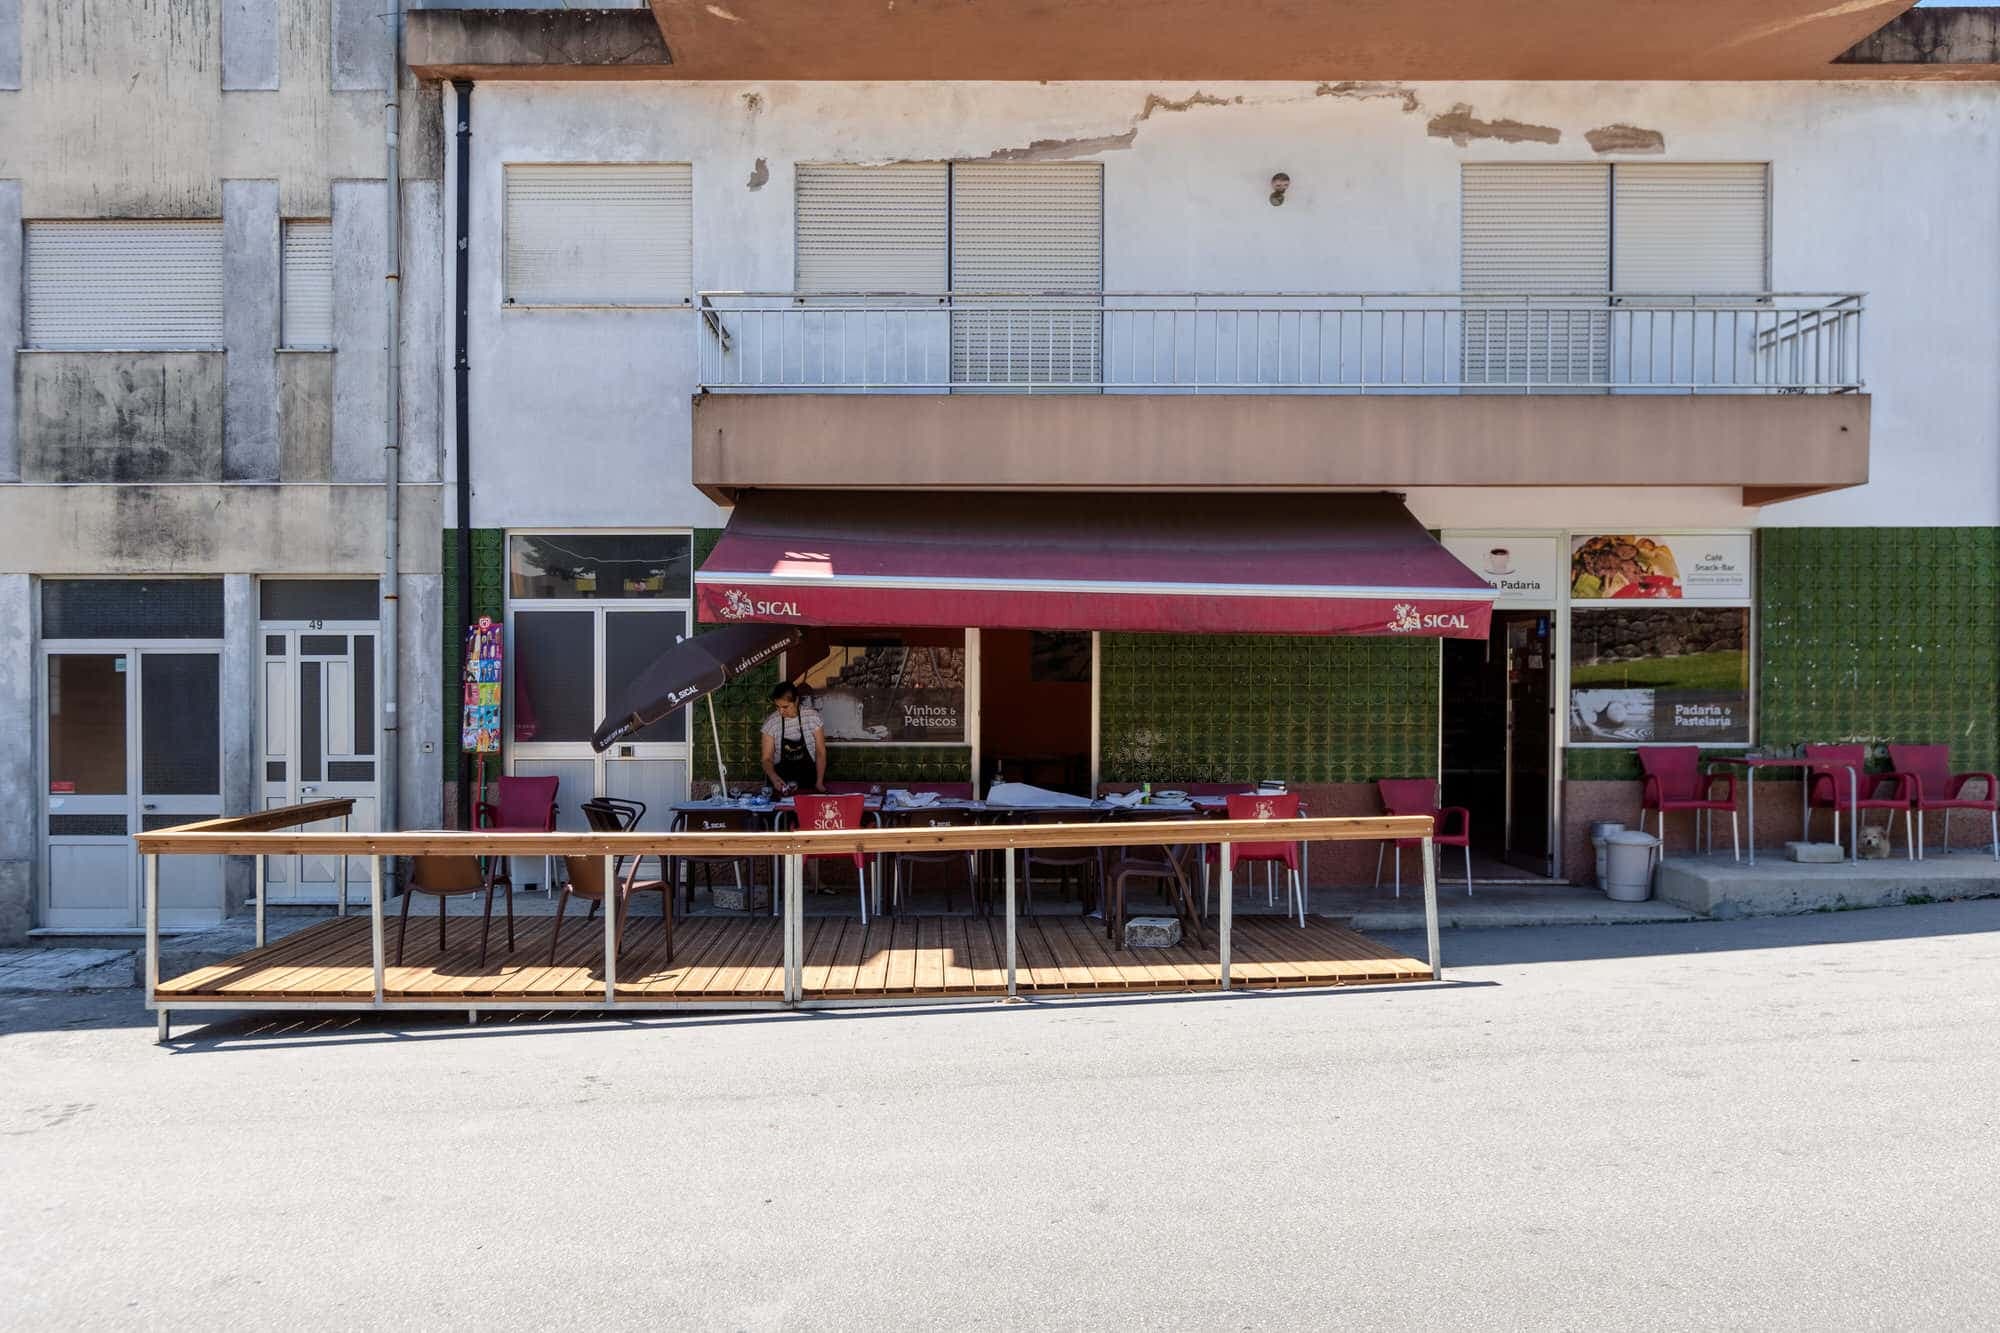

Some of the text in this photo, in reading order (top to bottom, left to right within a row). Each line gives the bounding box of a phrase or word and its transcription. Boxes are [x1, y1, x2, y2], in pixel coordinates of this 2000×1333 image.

[1501, 580, 1541, 590] Padaria
[757, 601, 801, 616] SICAL
[309, 618, 323, 630] 49
[1423, 614, 1469, 629] SICAL
[678, 684, 699, 699] SICAL
[904, 704, 947, 716] Vinhos
[1675, 704, 1721, 716] Padaria
[904, 715, 957, 727] Petiscos
[1674, 715, 1732, 727] Pastelaria
[814, 819, 846, 830] SICAL
